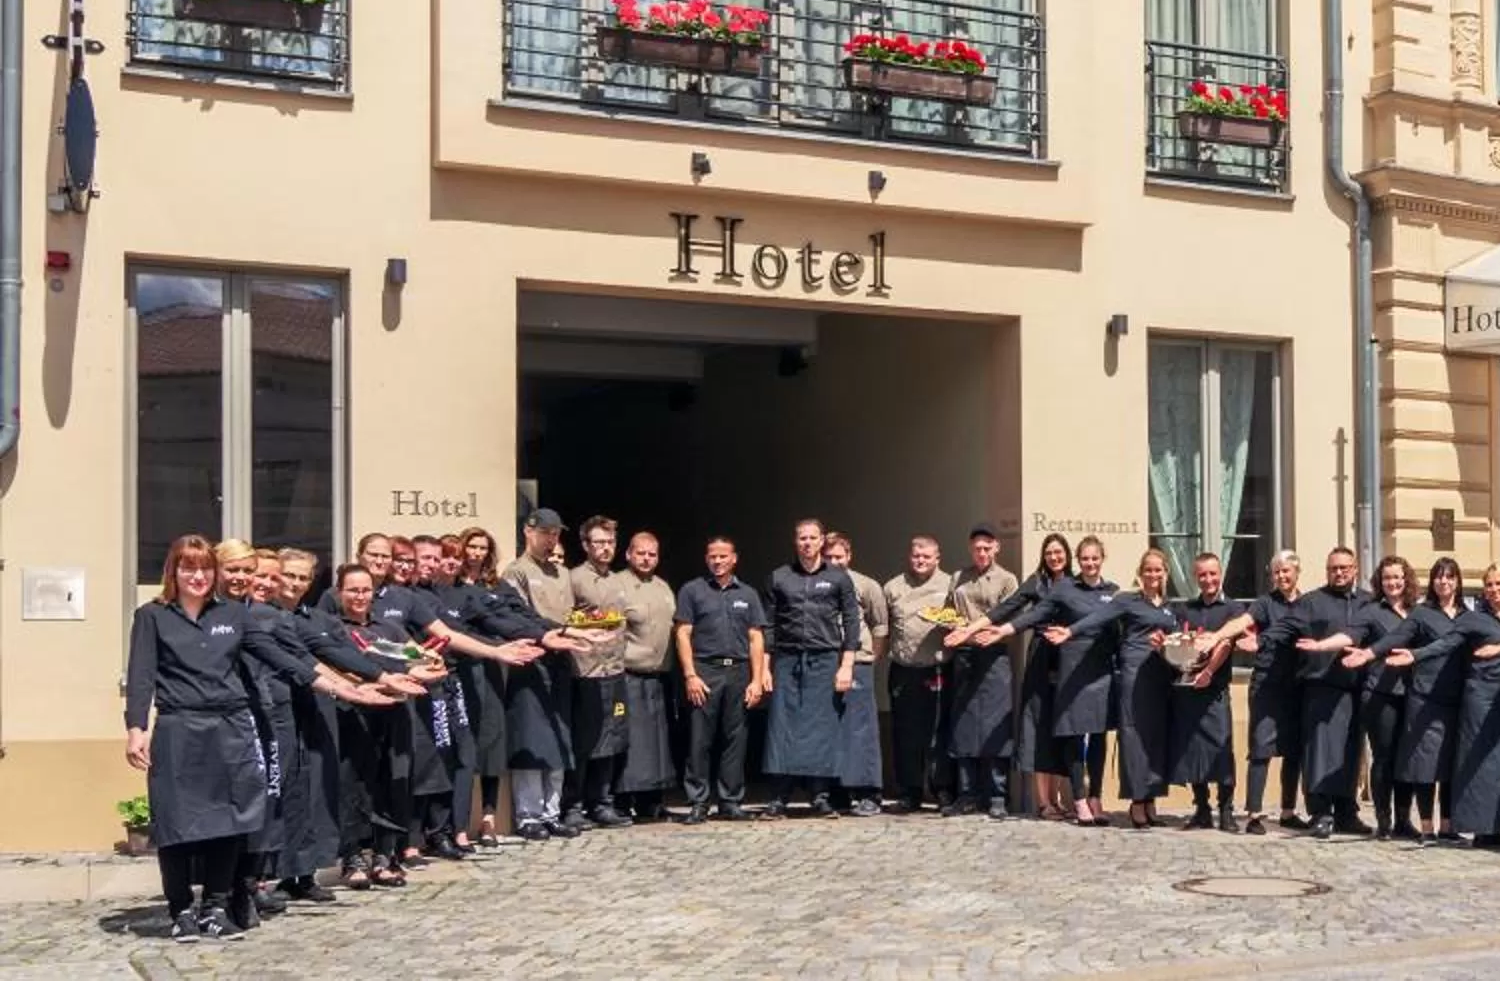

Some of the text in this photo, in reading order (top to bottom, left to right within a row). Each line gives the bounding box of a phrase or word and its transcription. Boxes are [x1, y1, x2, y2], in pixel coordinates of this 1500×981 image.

[668, 212, 892, 294] Hotel
[389, 490, 480, 518] Hotel
[1032, 512, 1140, 534] Restaurant
